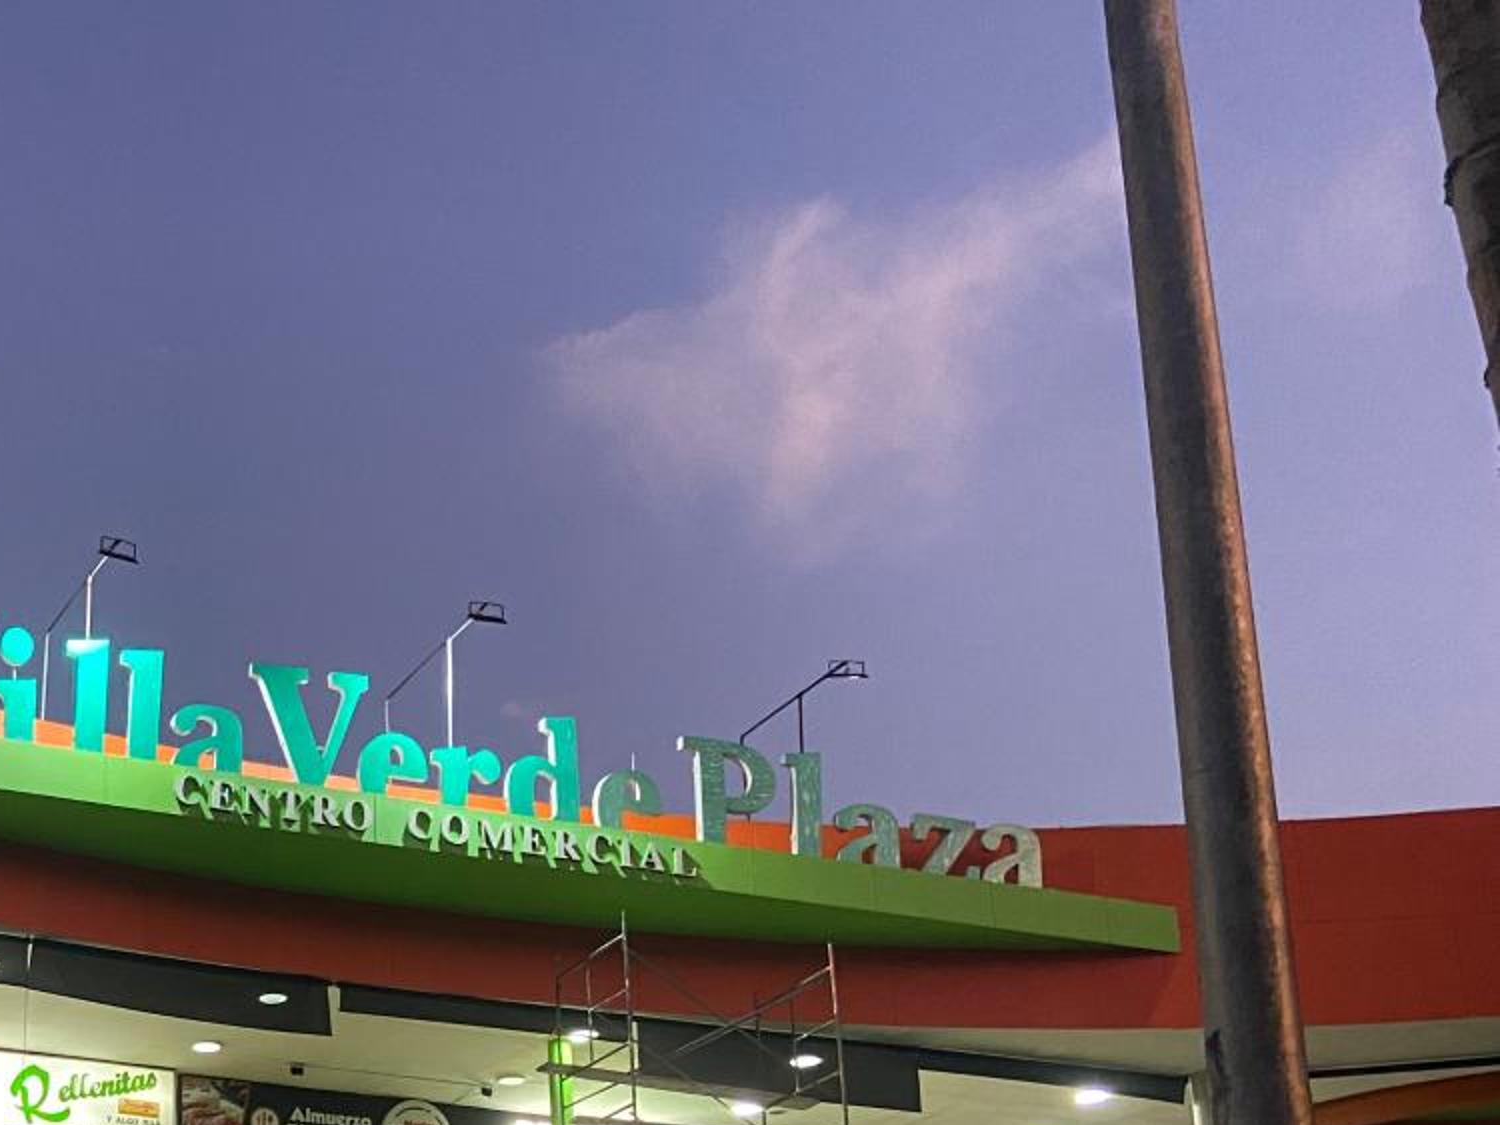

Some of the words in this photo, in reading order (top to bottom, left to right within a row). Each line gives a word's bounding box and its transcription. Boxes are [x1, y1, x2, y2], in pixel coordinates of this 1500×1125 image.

[174, 772, 373, 834] CENTRO
[407, 808, 699, 878] COMERCIAL
[676, 735, 1043, 889] Plaza
[10, 1063, 158, 1124] Rellenitas
